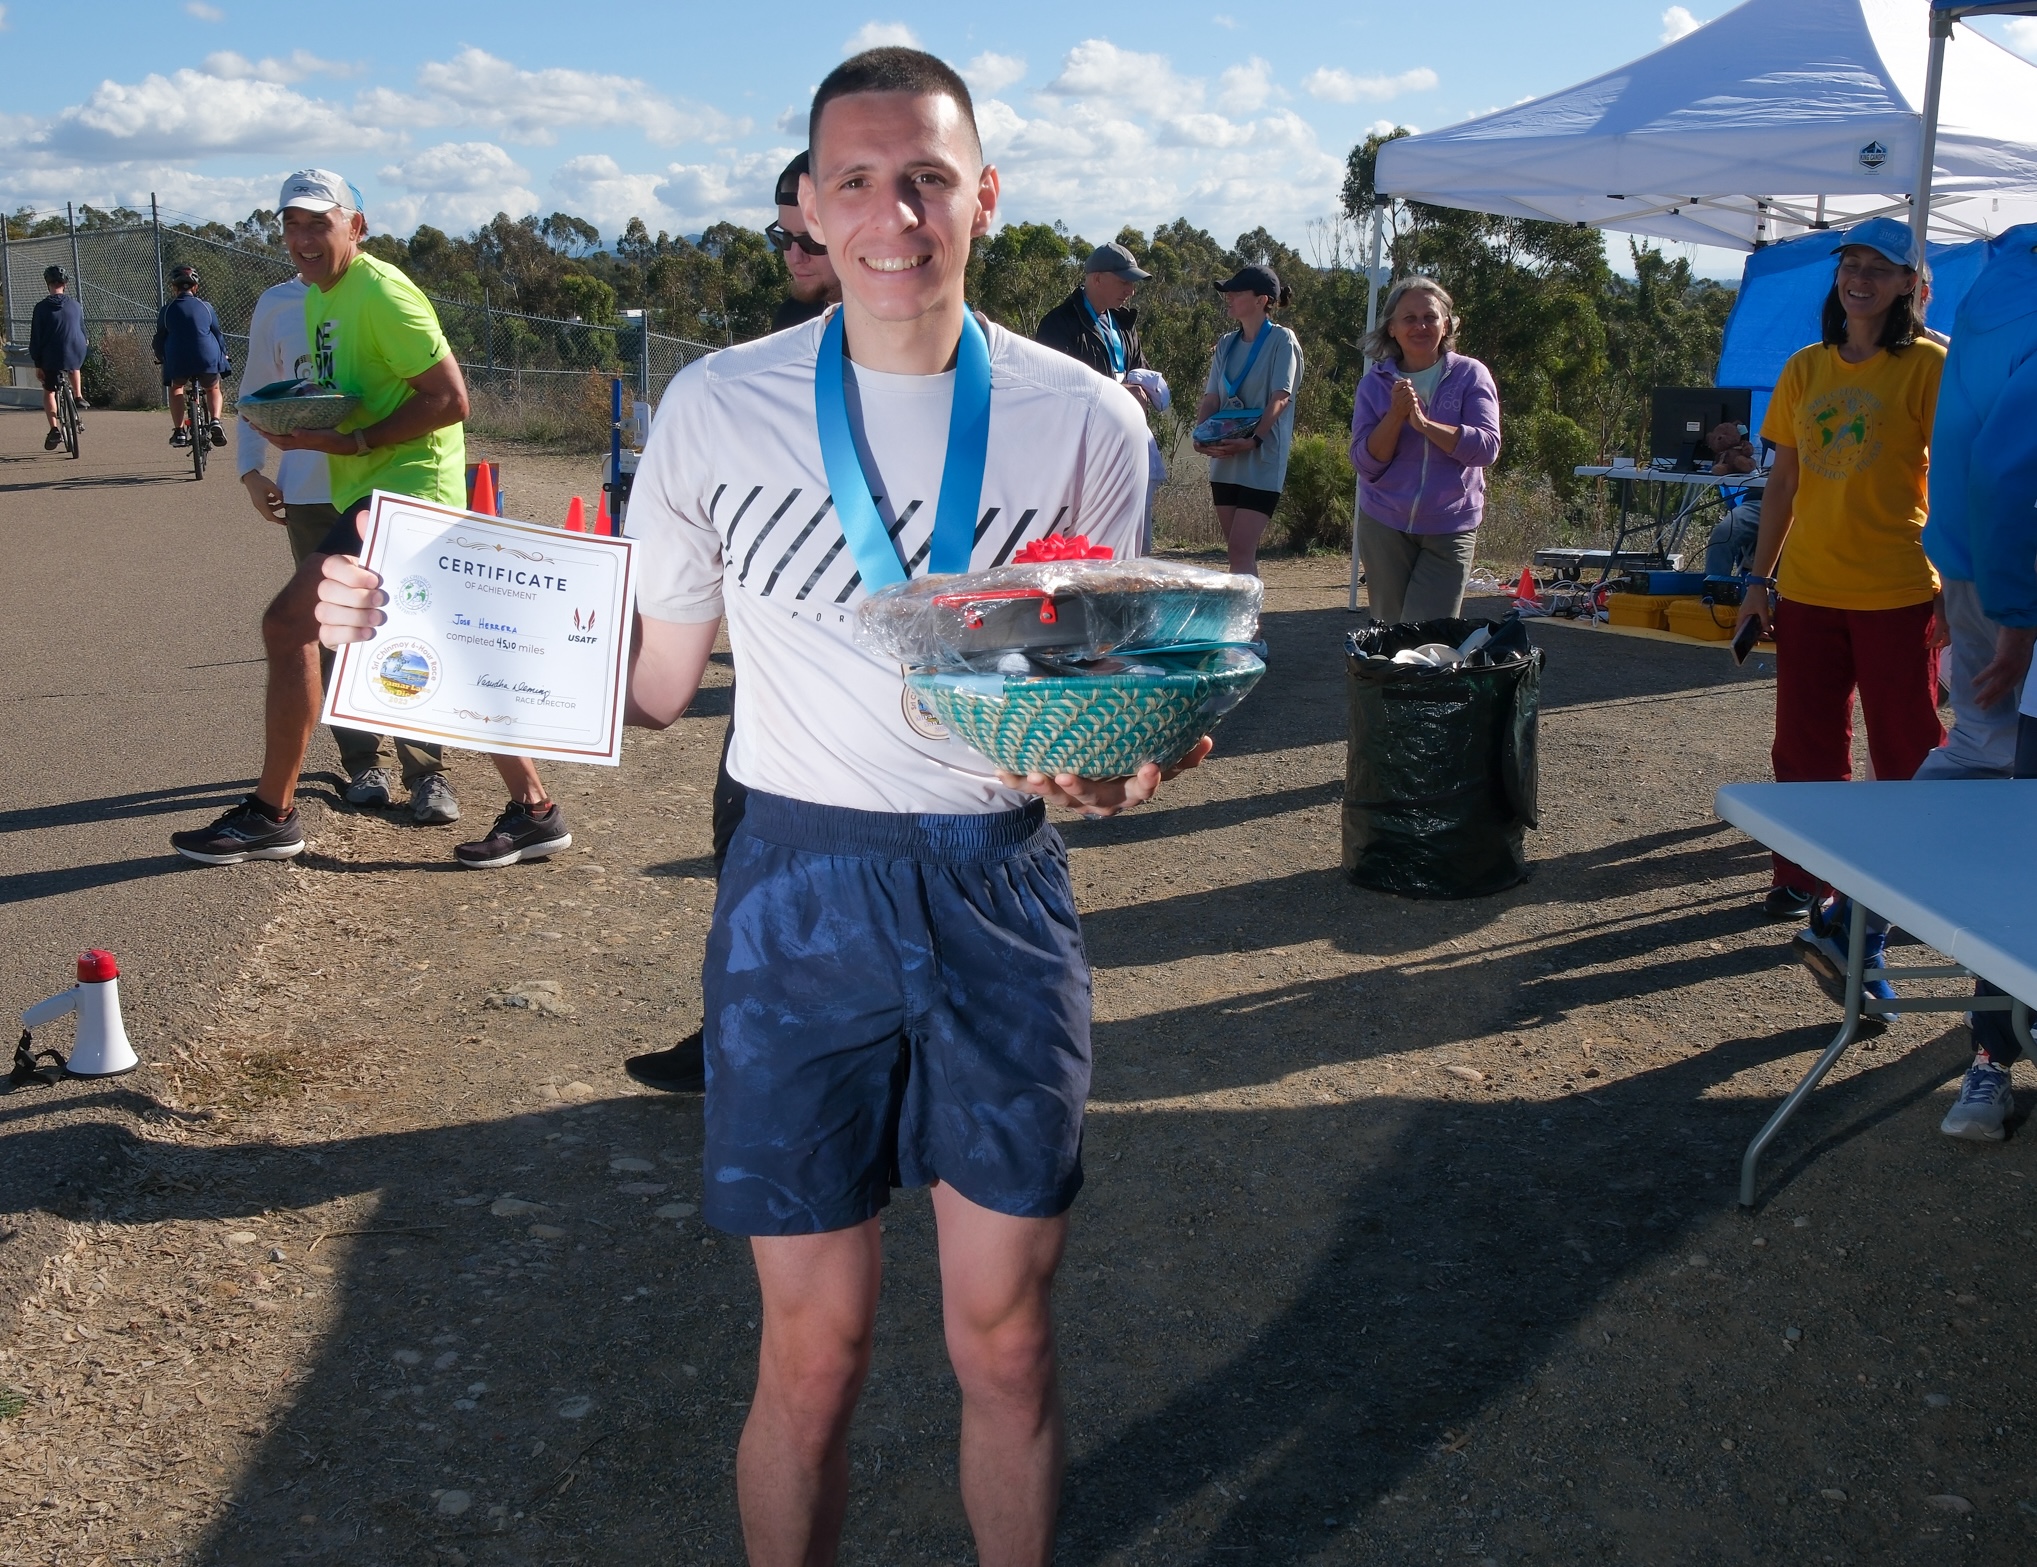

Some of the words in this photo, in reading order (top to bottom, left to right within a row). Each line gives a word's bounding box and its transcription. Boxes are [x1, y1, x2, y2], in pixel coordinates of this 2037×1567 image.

[438, 556, 568, 592] CERTIFICATE
[465, 581, 476, 590] OF
[477, 584, 538, 600] ACHIEVEMENT
[478, 618, 518, 634] HERRERA
[446, 632, 494, 647] completed
[518, 644, 545, 655] miles
[568, 634, 598, 644] USATF
[372, 661, 380, 670] Sri
[376, 642, 409, 660] Chinmoy
[411, 642, 434, 660] 6-Hour
[372, 676, 410, 690] Miramar
[411, 684, 431, 694] Lake
[379, 686, 394, 694] San
[396, 690, 420, 700] Diego
[388, 696, 408, 704] 2023
[516, 696, 535, 705] RACE
[537, 697, 576, 710] DIRECTOR
